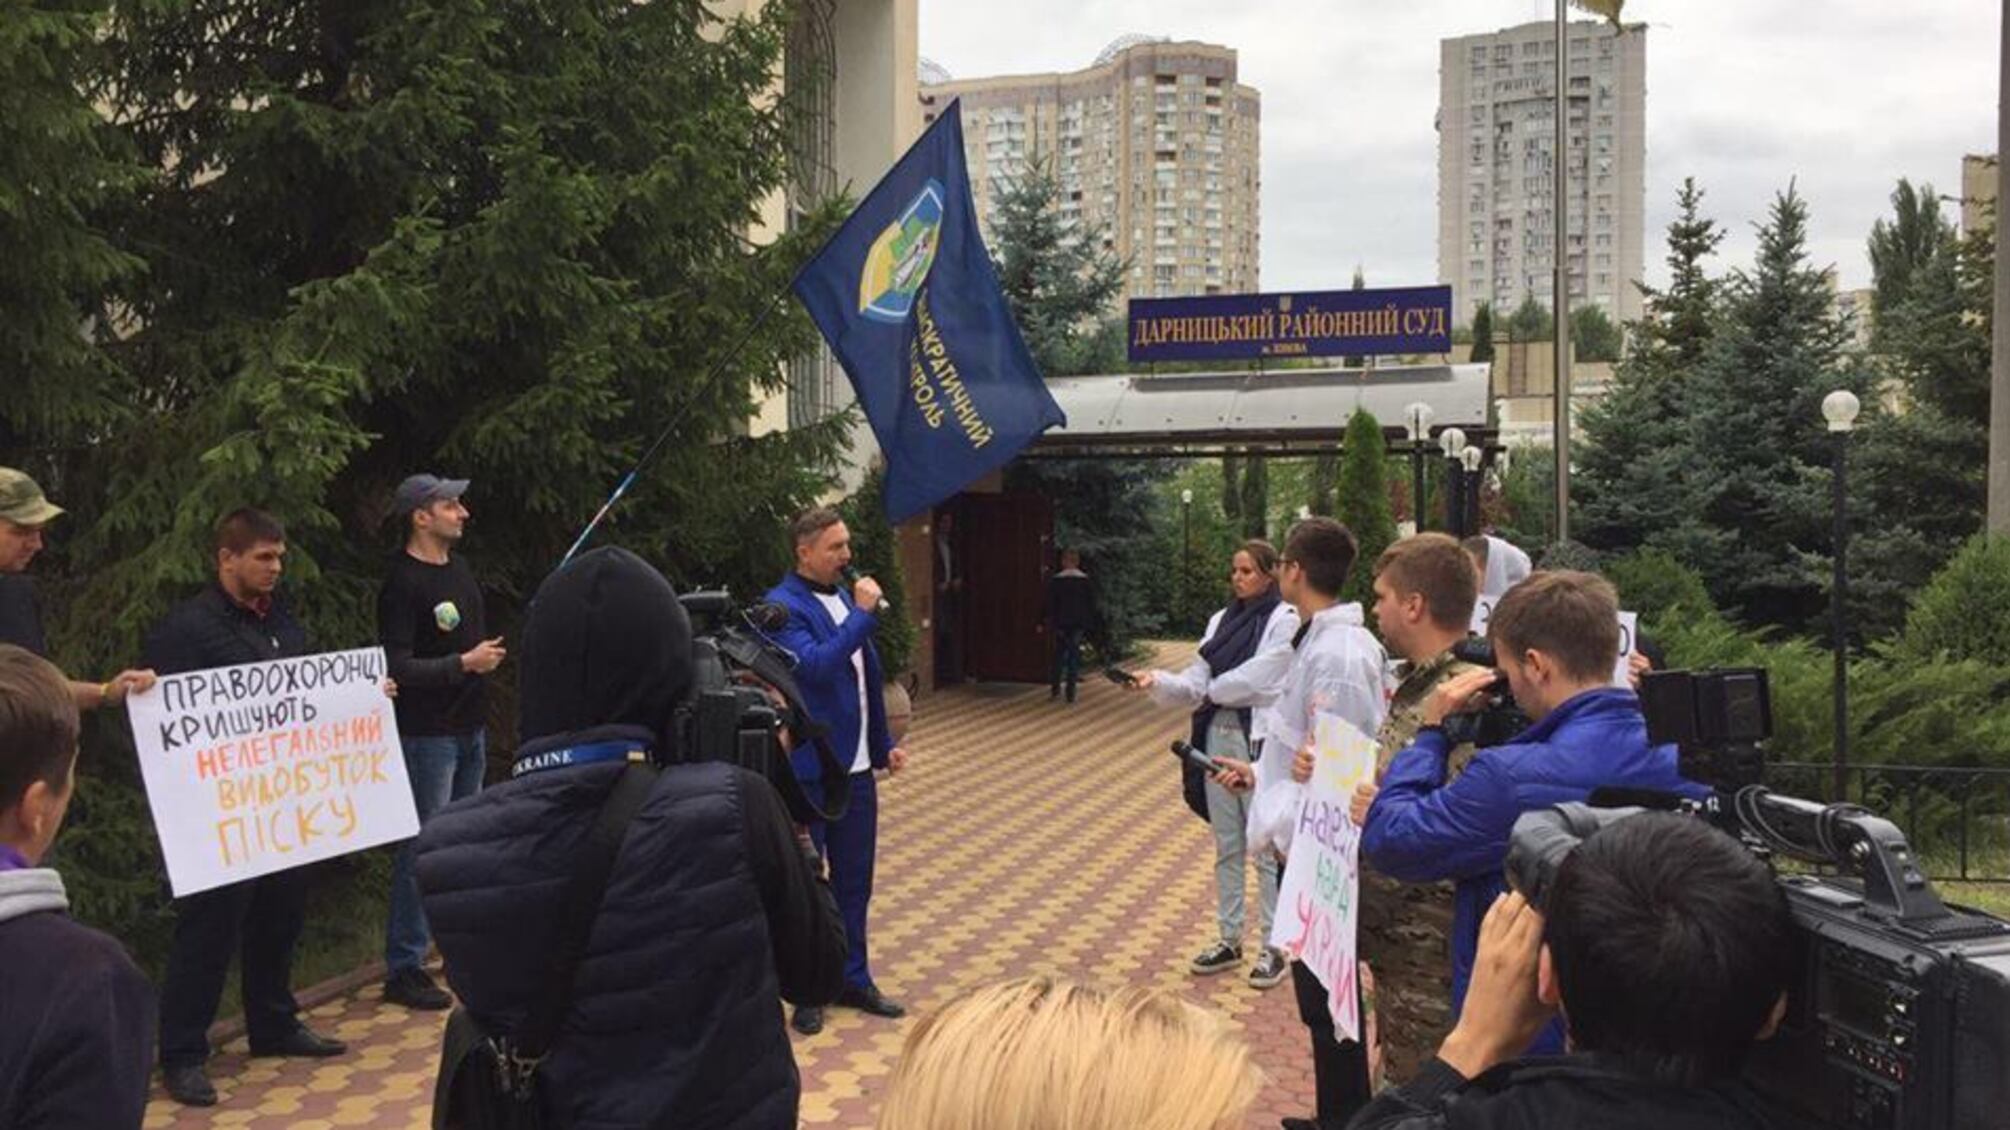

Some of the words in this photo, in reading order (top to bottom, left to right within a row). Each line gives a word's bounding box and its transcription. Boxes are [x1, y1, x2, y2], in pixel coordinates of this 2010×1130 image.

[1134, 308, 1274, 346] ДАРНИЦЬКИЙ
[1279, 303, 1399, 338] РАЙОННИЙ
[1403, 307, 1445, 337] СУД
[163, 653, 384, 713] ПРАВООХОРОНЦІ
[160, 697, 317, 751] КРИШУЮТЬ
[217, 747, 389, 812] ВИДОБУТОК
[217, 795, 358, 868] ПІСКУ
